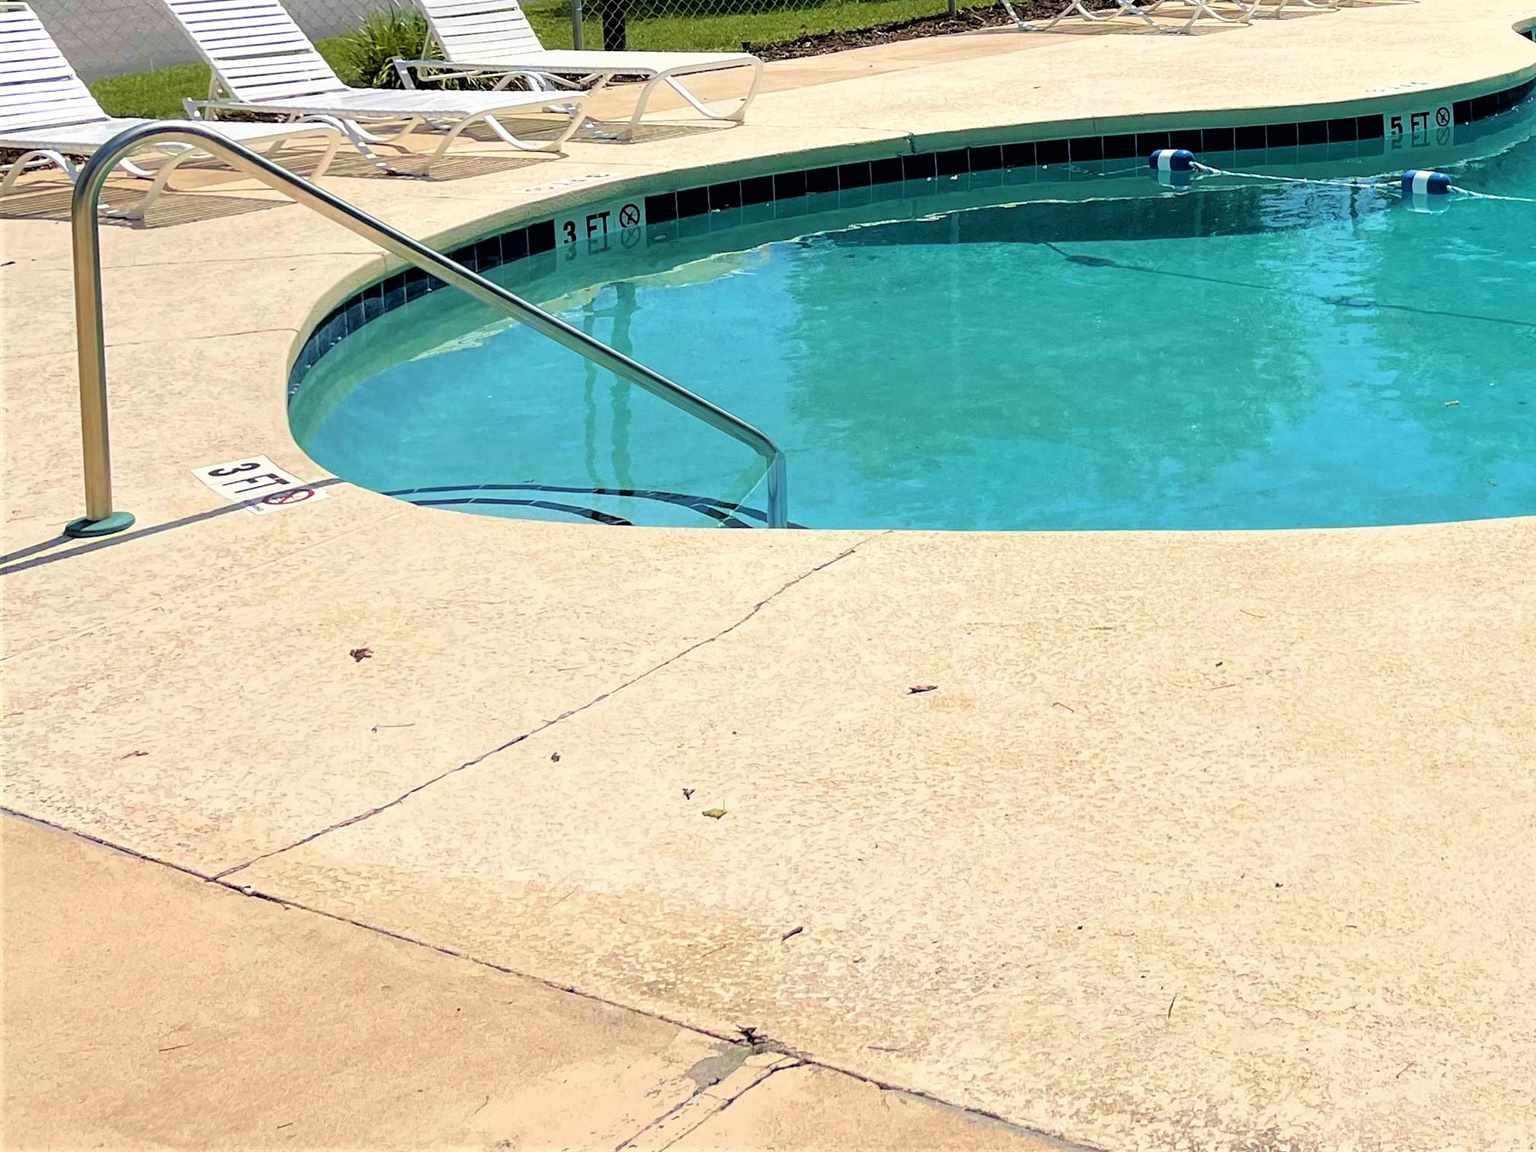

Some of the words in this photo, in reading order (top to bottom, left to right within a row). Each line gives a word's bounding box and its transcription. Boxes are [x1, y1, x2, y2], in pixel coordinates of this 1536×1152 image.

[1390, 116, 1404, 135] 5
[1410, 111, 1430, 132] FT
[563, 221, 577, 244] 3
[585, 210, 611, 240] FT
[207, 462, 262, 477] 3
[221, 473, 291, 494] FT
